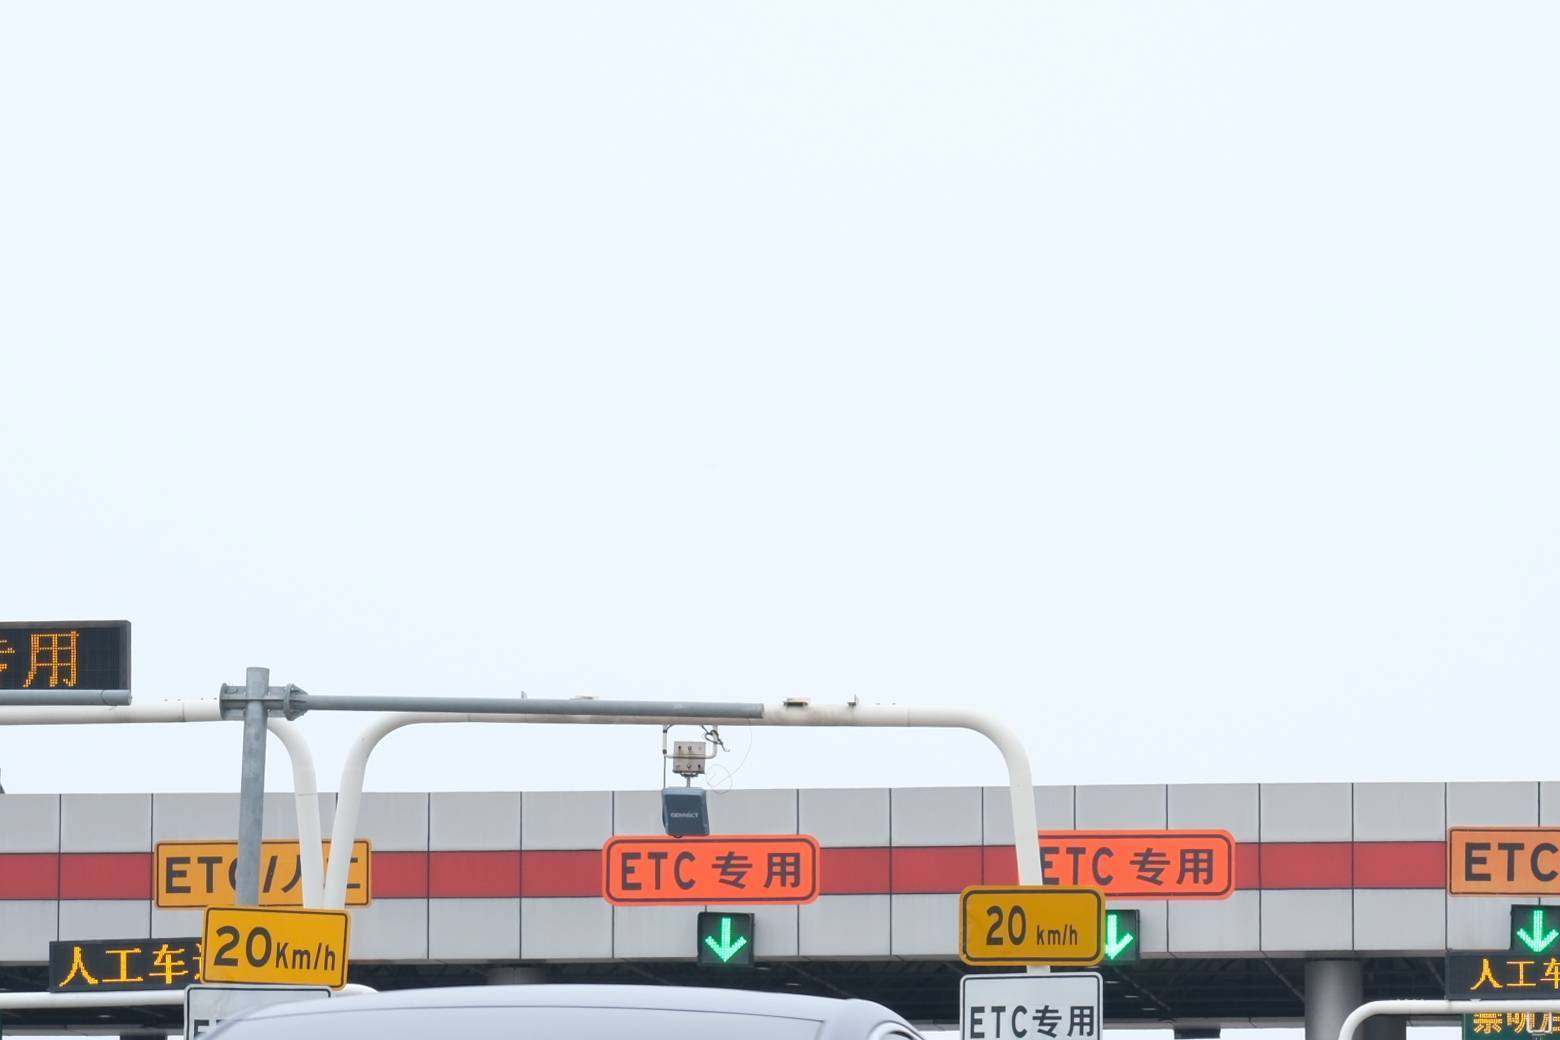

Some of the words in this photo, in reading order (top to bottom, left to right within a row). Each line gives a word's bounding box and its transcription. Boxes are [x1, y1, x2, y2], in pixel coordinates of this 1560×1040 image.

[0, 631, 79, 687] 用
[621, 853, 696, 890] ETC
[712, 851, 801, 890] 专用
[1040, 849, 1114, 886] ETC
[1130, 847, 1214, 886] 专用
[1465, 843, 1559, 881] ETC
[986, 905, 1027, 946] 20
[1036, 924, 1078, 948] km/h
[59, 943, 202, 987] 人工车
[970, 1005, 1095, 1039] ETC专用
